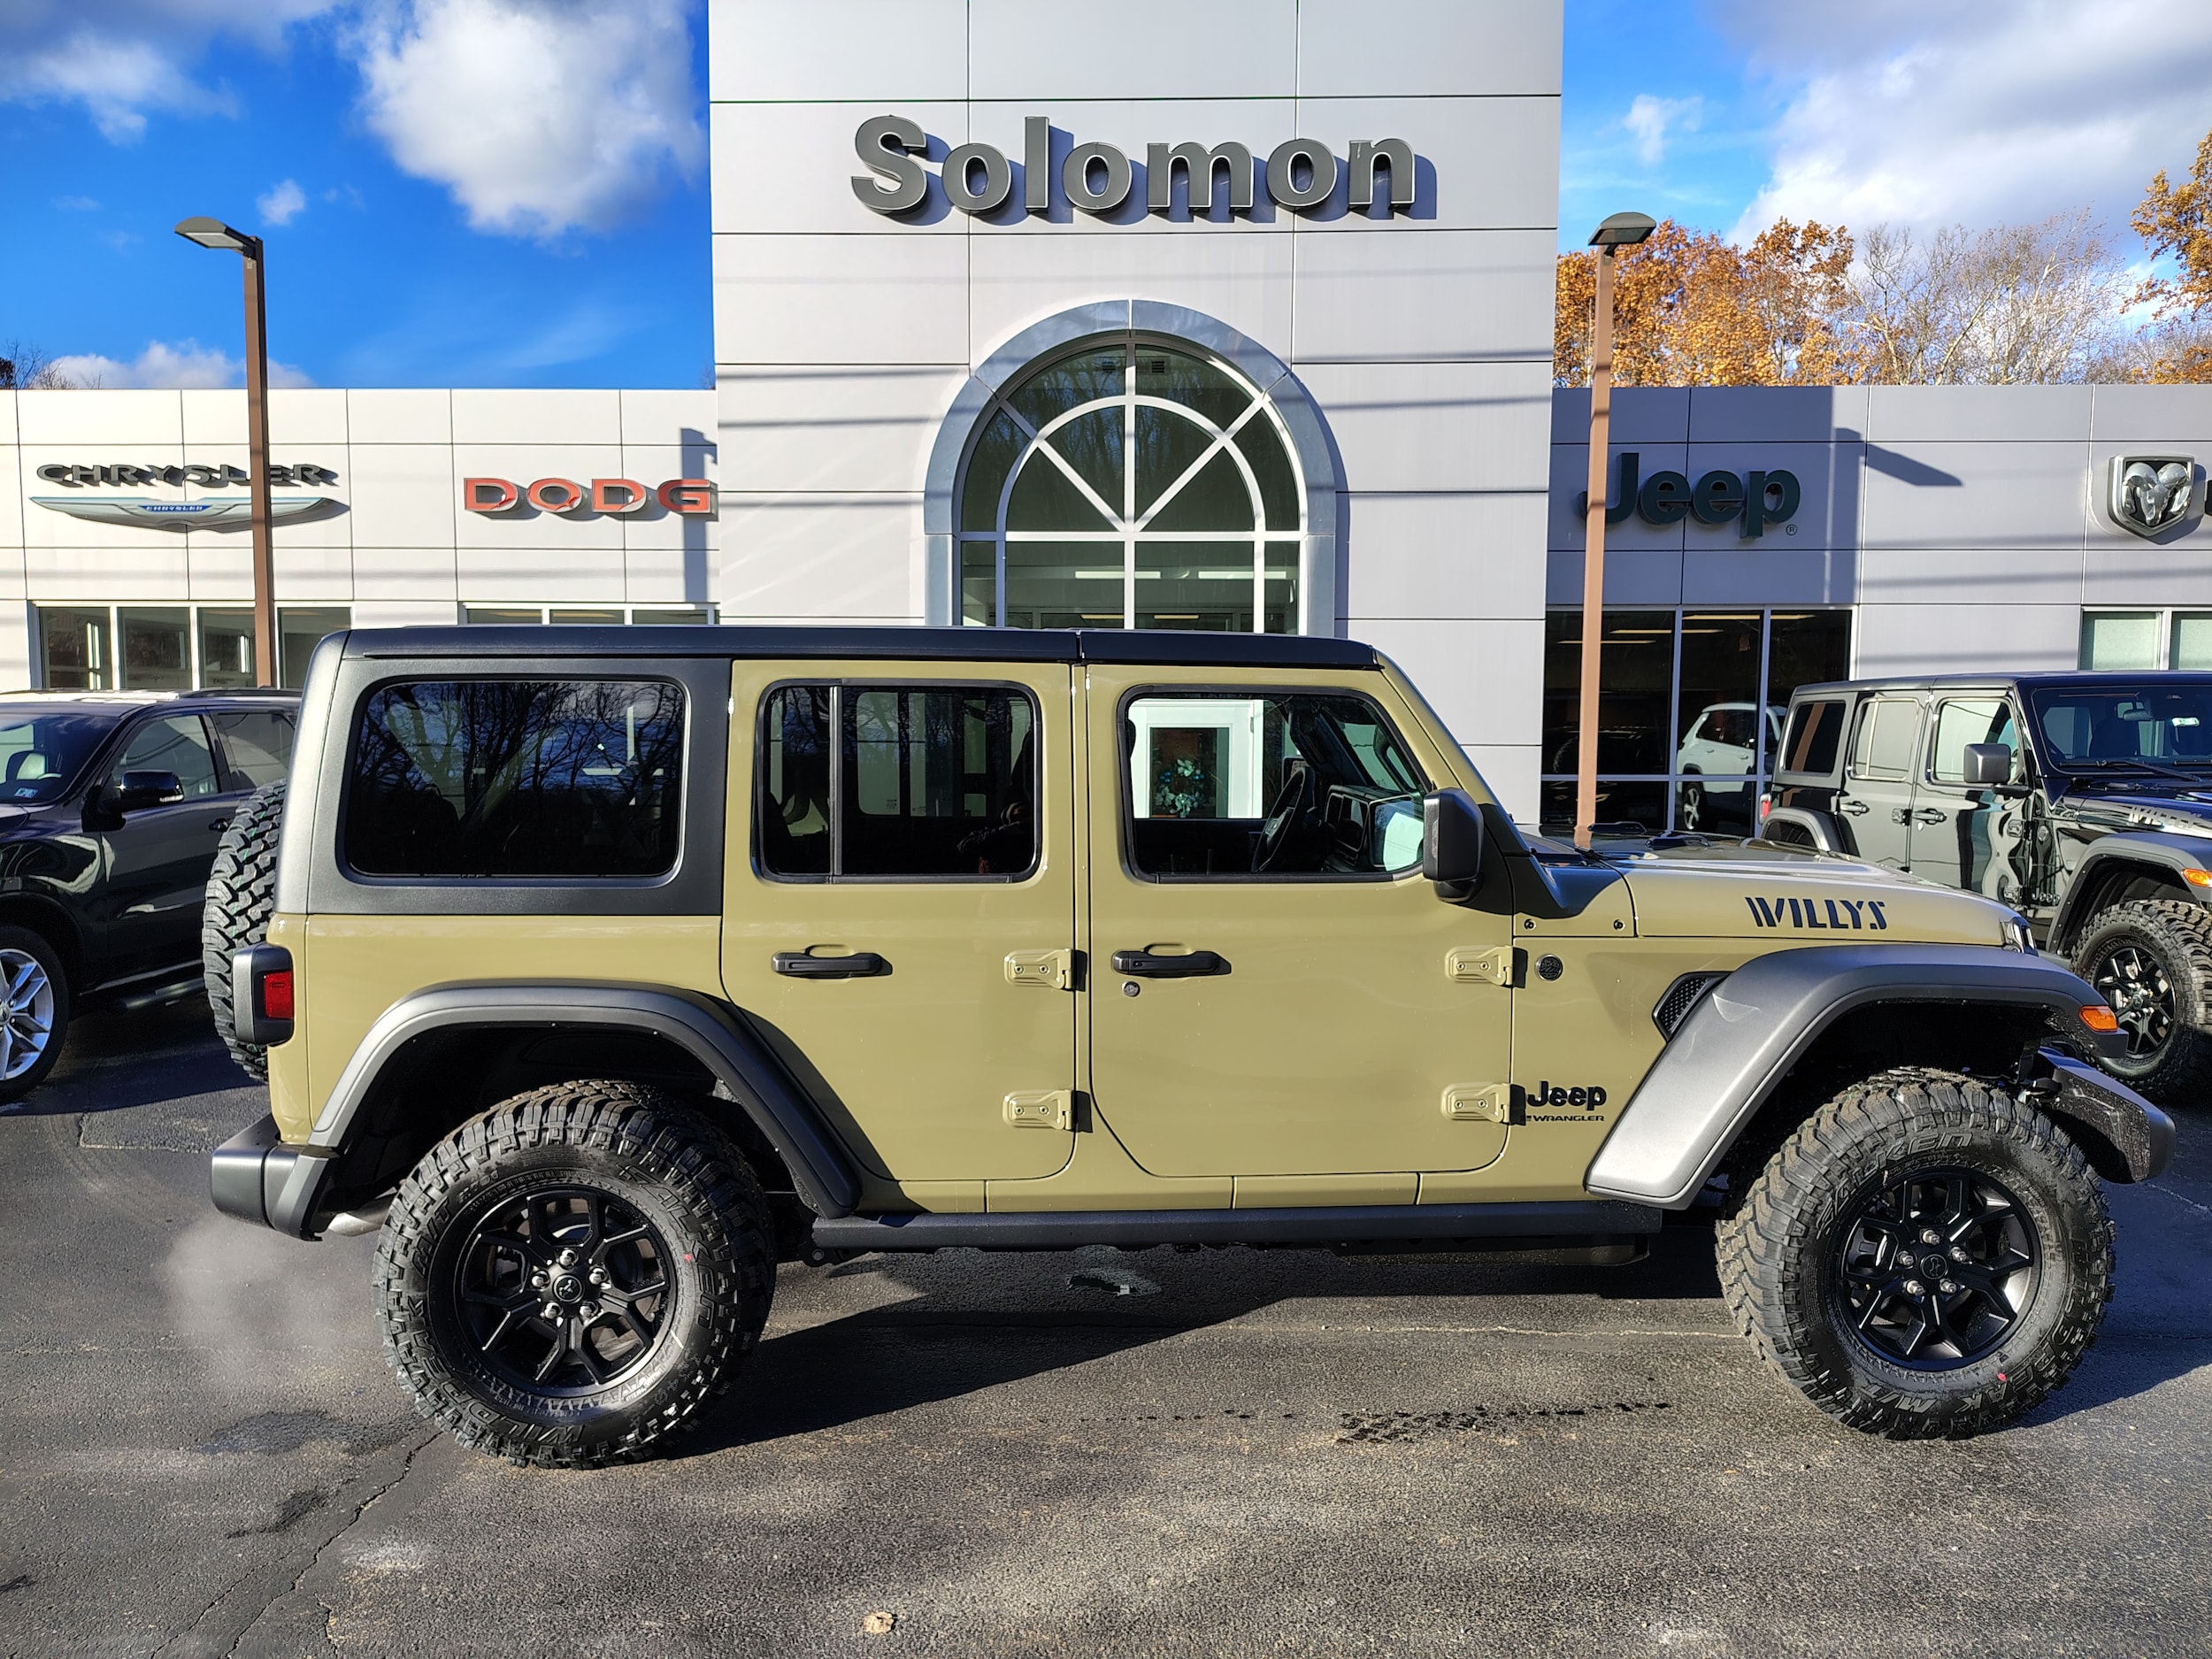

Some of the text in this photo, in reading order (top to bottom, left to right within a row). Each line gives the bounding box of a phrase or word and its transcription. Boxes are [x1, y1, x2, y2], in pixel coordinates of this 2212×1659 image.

[851, 114, 1417, 213] Solomon
[37, 464, 325, 484] CHRYSLER
[1579, 452, 1801, 538] Jeep
[1744, 896, 1888, 930] WILLYS
[2032, 887, 2061, 906] Jeep
[1527, 1080, 1607, 1111] Jeep
[1816, 1132, 1973, 1240] FALKEN
